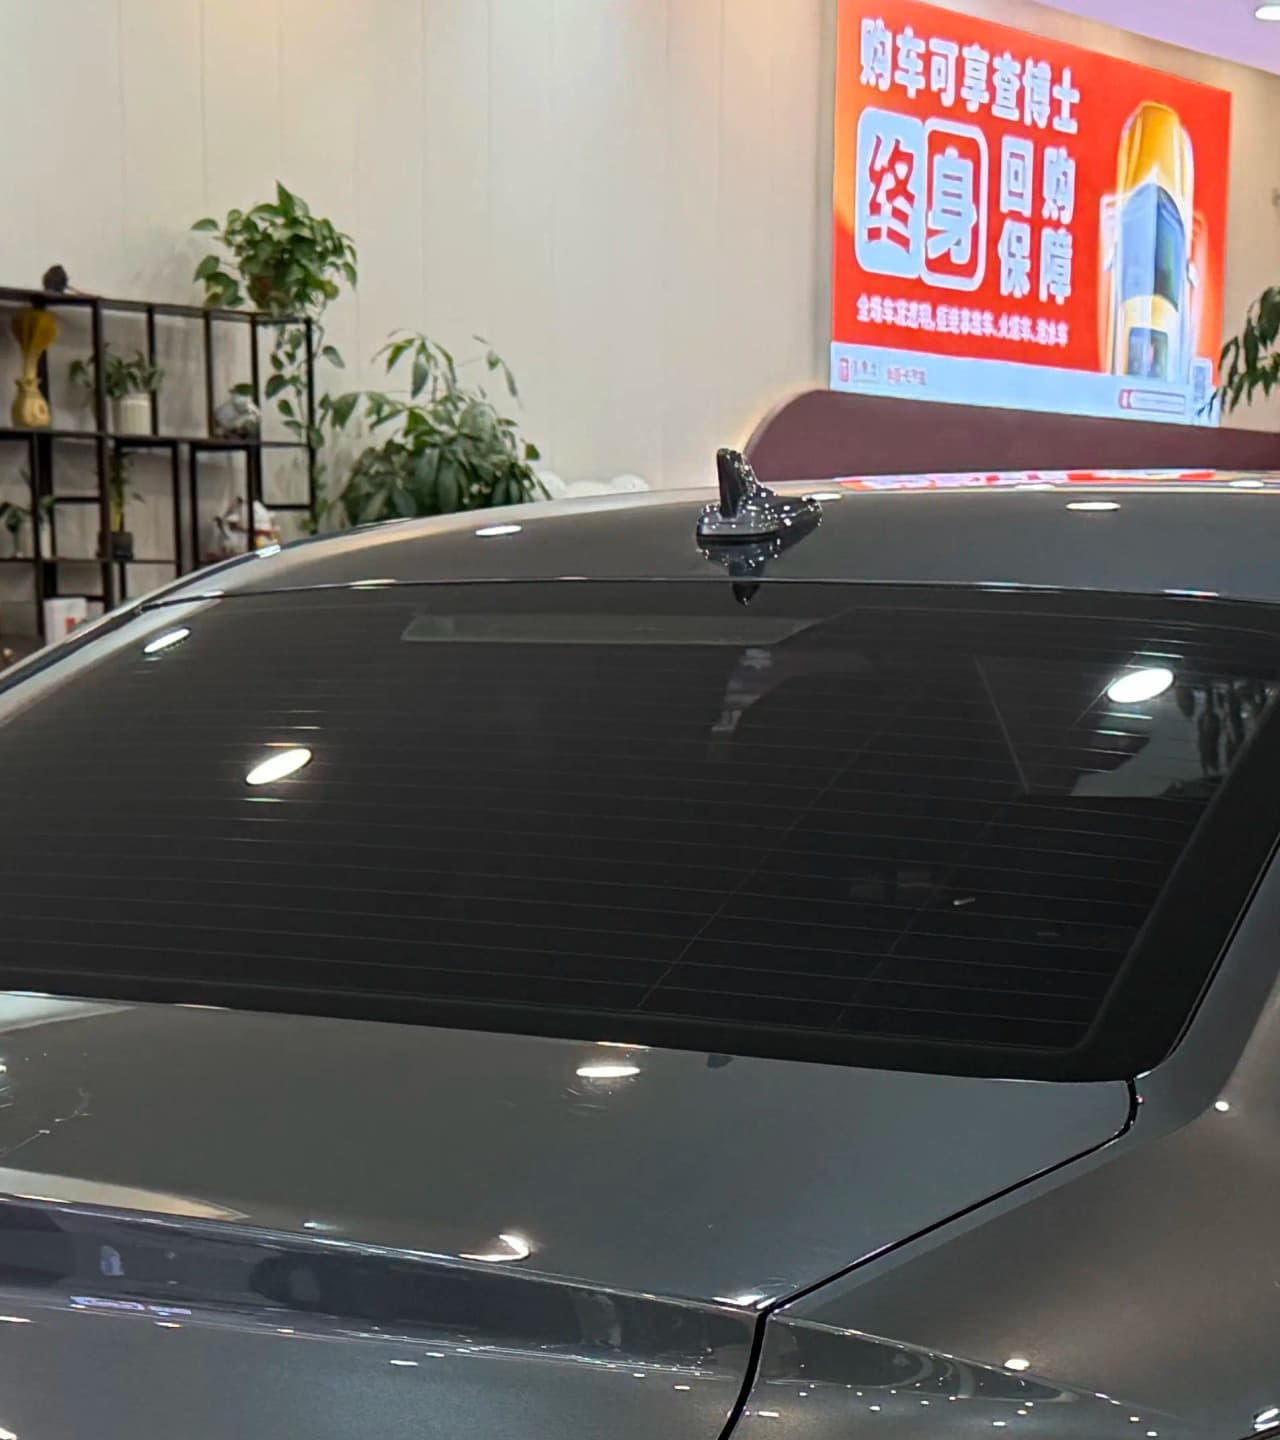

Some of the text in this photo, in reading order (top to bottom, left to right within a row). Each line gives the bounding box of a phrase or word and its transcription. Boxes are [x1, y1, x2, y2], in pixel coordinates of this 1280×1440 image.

[860, 17, 1080, 135] 购车可享查博士
[866, 131, 978, 266] 终身
[1000, 134, 1076, 224] 回购
[997, 218, 1074, 305] 保障
